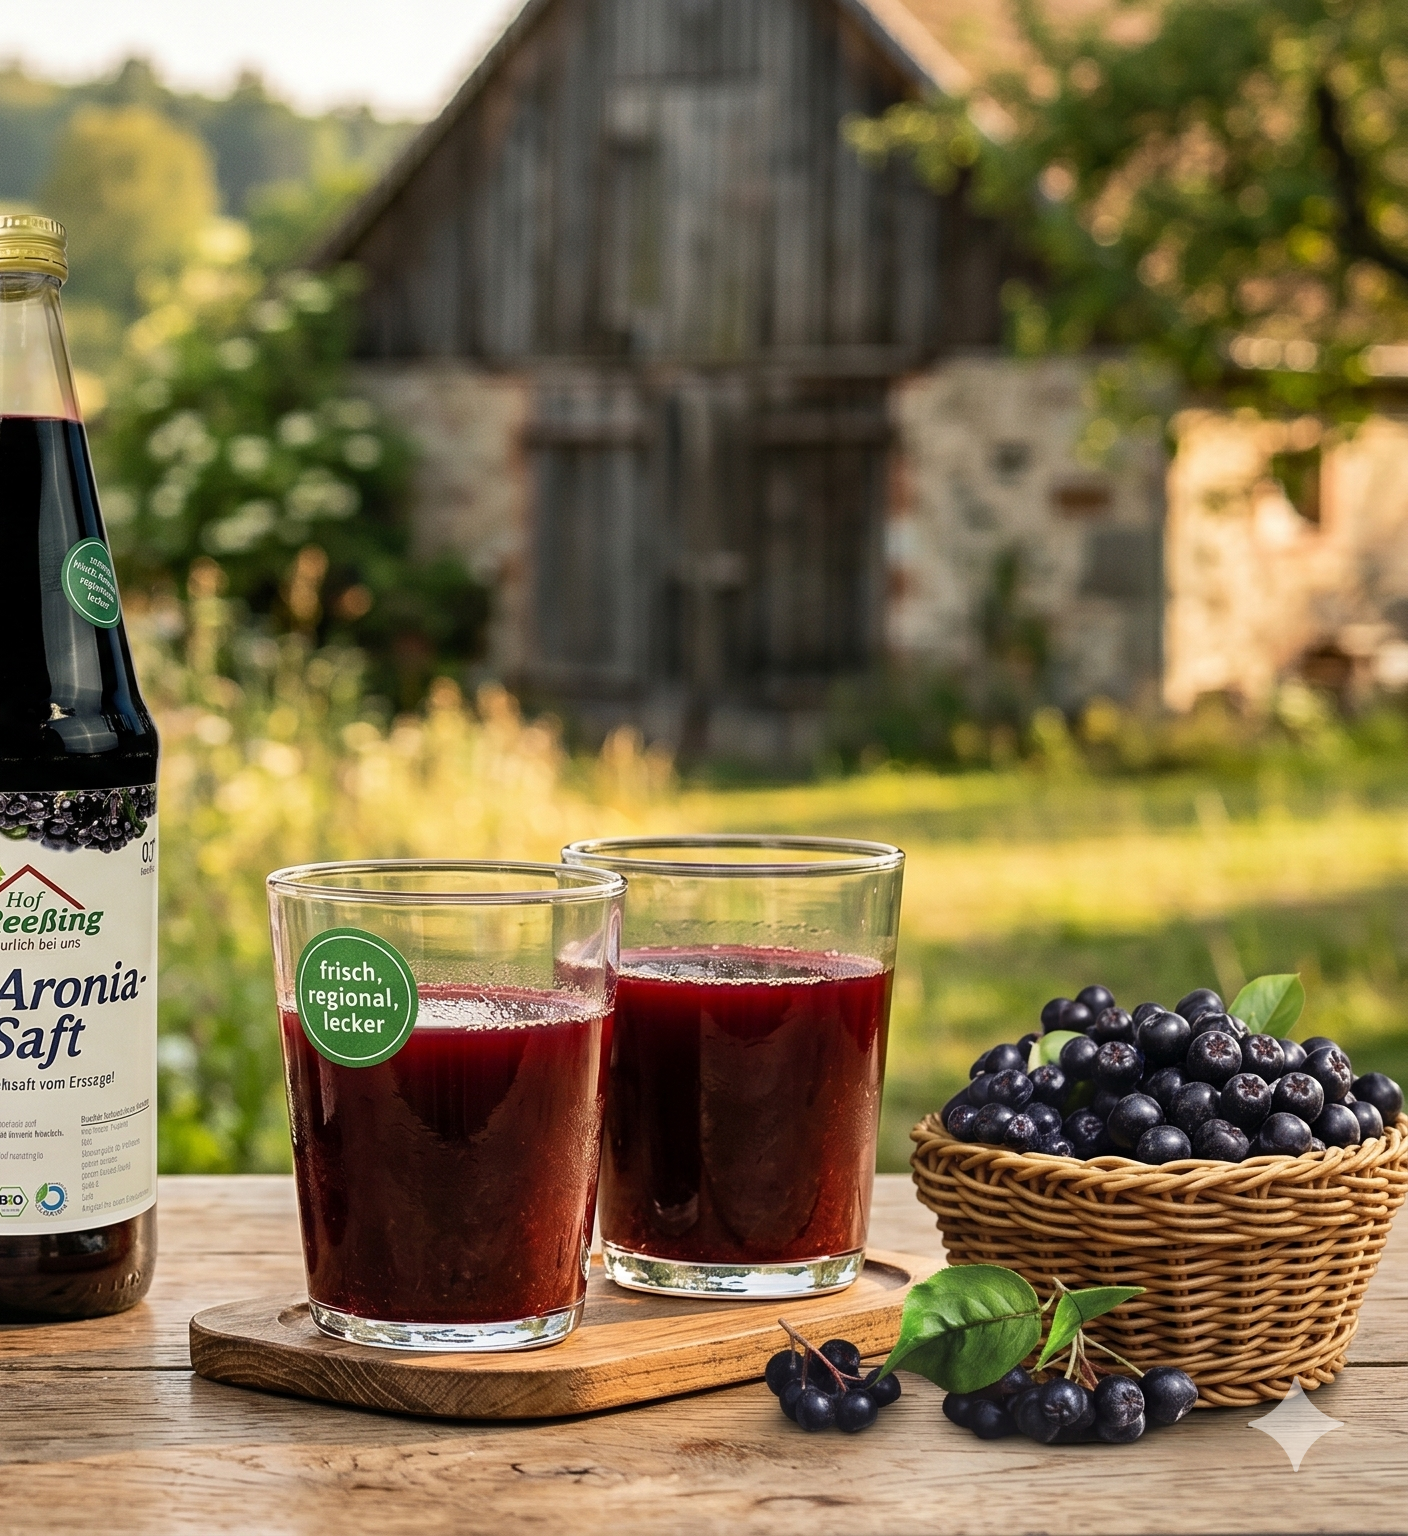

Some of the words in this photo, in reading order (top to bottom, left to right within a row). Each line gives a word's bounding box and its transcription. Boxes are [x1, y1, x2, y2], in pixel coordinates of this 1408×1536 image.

[6, 891, 46, 911] Hof
[39, 938, 57, 951] bei
[60, 939, 81, 950] uns
[320, 960, 382, 985] frisch,
[308, 987, 399, 1011] regional,
[324, 1011, 385, 1033] lecker
[40, 1078, 65, 1090] vom
